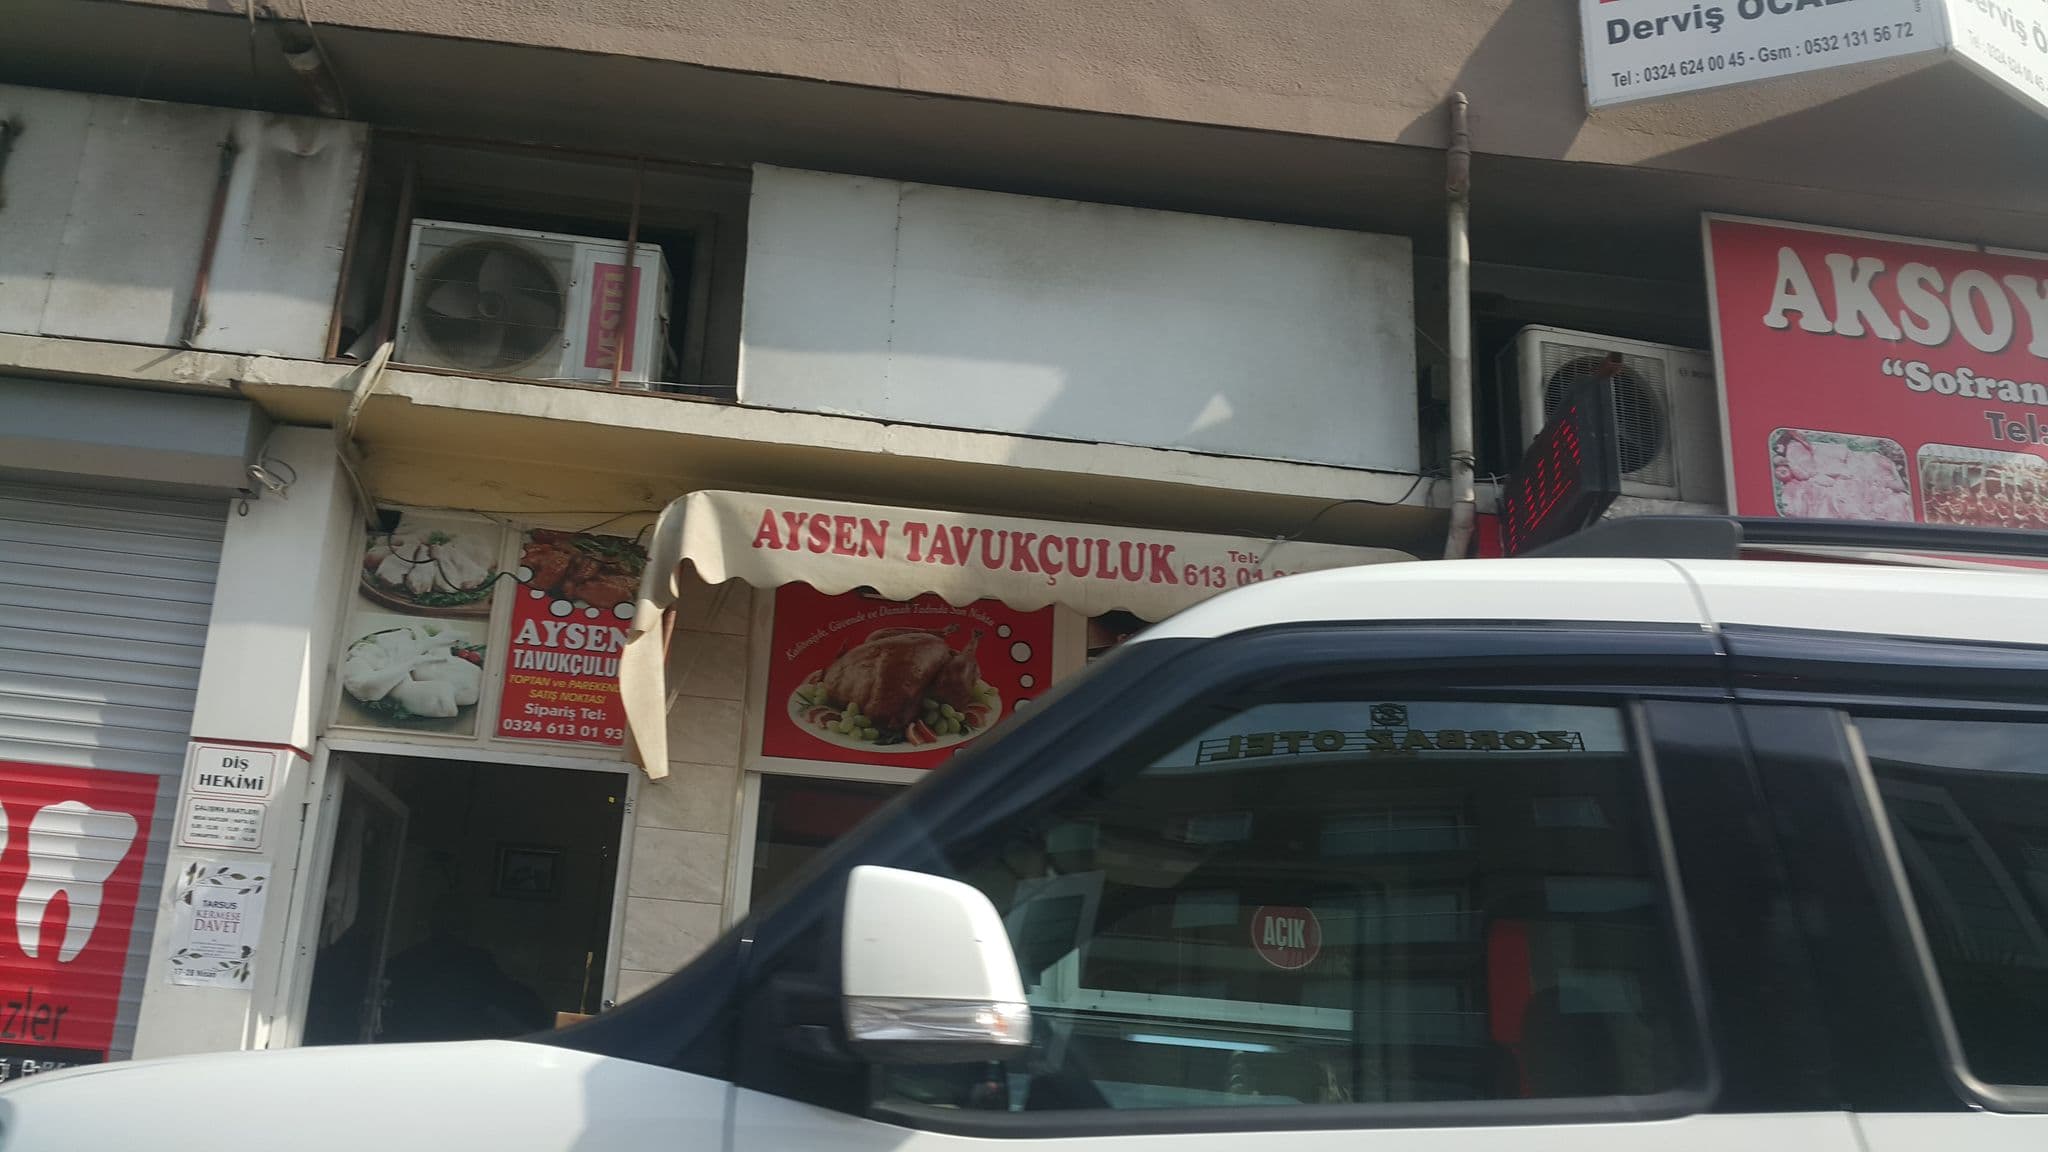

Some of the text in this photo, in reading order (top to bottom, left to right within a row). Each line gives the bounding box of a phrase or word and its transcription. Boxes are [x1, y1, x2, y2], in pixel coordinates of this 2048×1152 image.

[1606, 4, 1725, 45] Derviş
[1967, 0, 2028, 47] erviş
[1611, 71, 1632, 87] Tel
[1644, 63, 1676, 82] 0324
[1680, 59, 1704, 76] 624
[1708, 55, 1725, 71] 00
[1728, 51, 1745, 67] 45
[1758, 46, 1792, 62] Gsm
[1804, 35, 1839, 54] 0532
[1843, 29, 1868, 47] 131
[1873, 25, 1891, 42] 56
[1894, 21, 1914, 38] 72
[751, 508, 1179, 586] AYSEN TAVUKÇULUK
[1228, 550, 1260, 564] Tel:
[1183, 563, 1226, 588] 613
[514, 618, 628, 653] AYSEN
[513, 649, 619, 677] TAVUKÇULU
[509, 674, 551, 686] TOPTAN
[568, 680, 621, 693] PAREKEN
[524, 703, 606, 721] Sipariş Tel:
[502, 718, 624, 740] 0324 613 01 93
[222, 755, 250, 772] DİŞ
[199, 774, 265, 791] HEKİMİ
[202, 900, 238, 909] TARSUS
[1263, 916, 1306, 950] AÇIK
